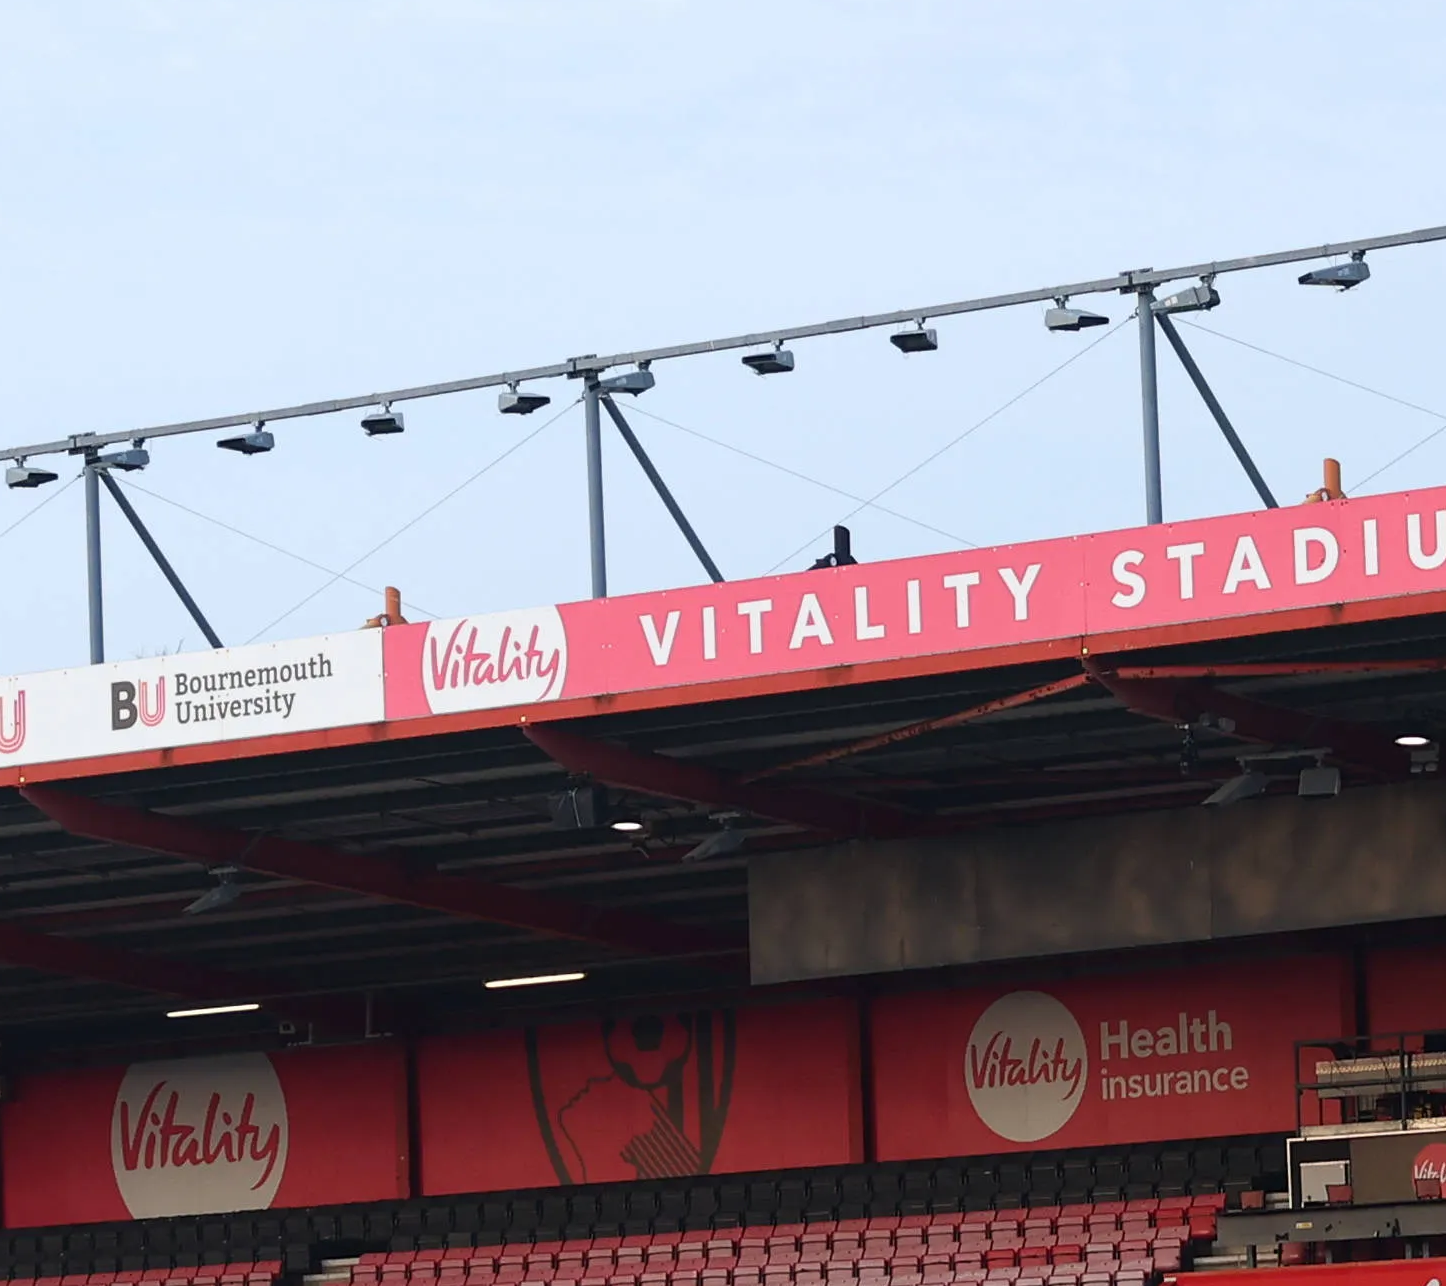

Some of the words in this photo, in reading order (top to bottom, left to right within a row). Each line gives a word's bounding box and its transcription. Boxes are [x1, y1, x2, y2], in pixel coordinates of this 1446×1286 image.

[639, 564, 1043, 666] VITALITY
[110, 675, 165, 731] BU
[174, 654, 334, 697] Bournemouth
[429, 619, 563, 702] Vitality
[175, 688, 296, 725] University
[971, 1030, 1082, 1101] Vitality
[1099, 1010, 1233, 1061] Health
[1101, 1066, 1250, 1100] insurance
[120, 1080, 280, 1191] Vitality
